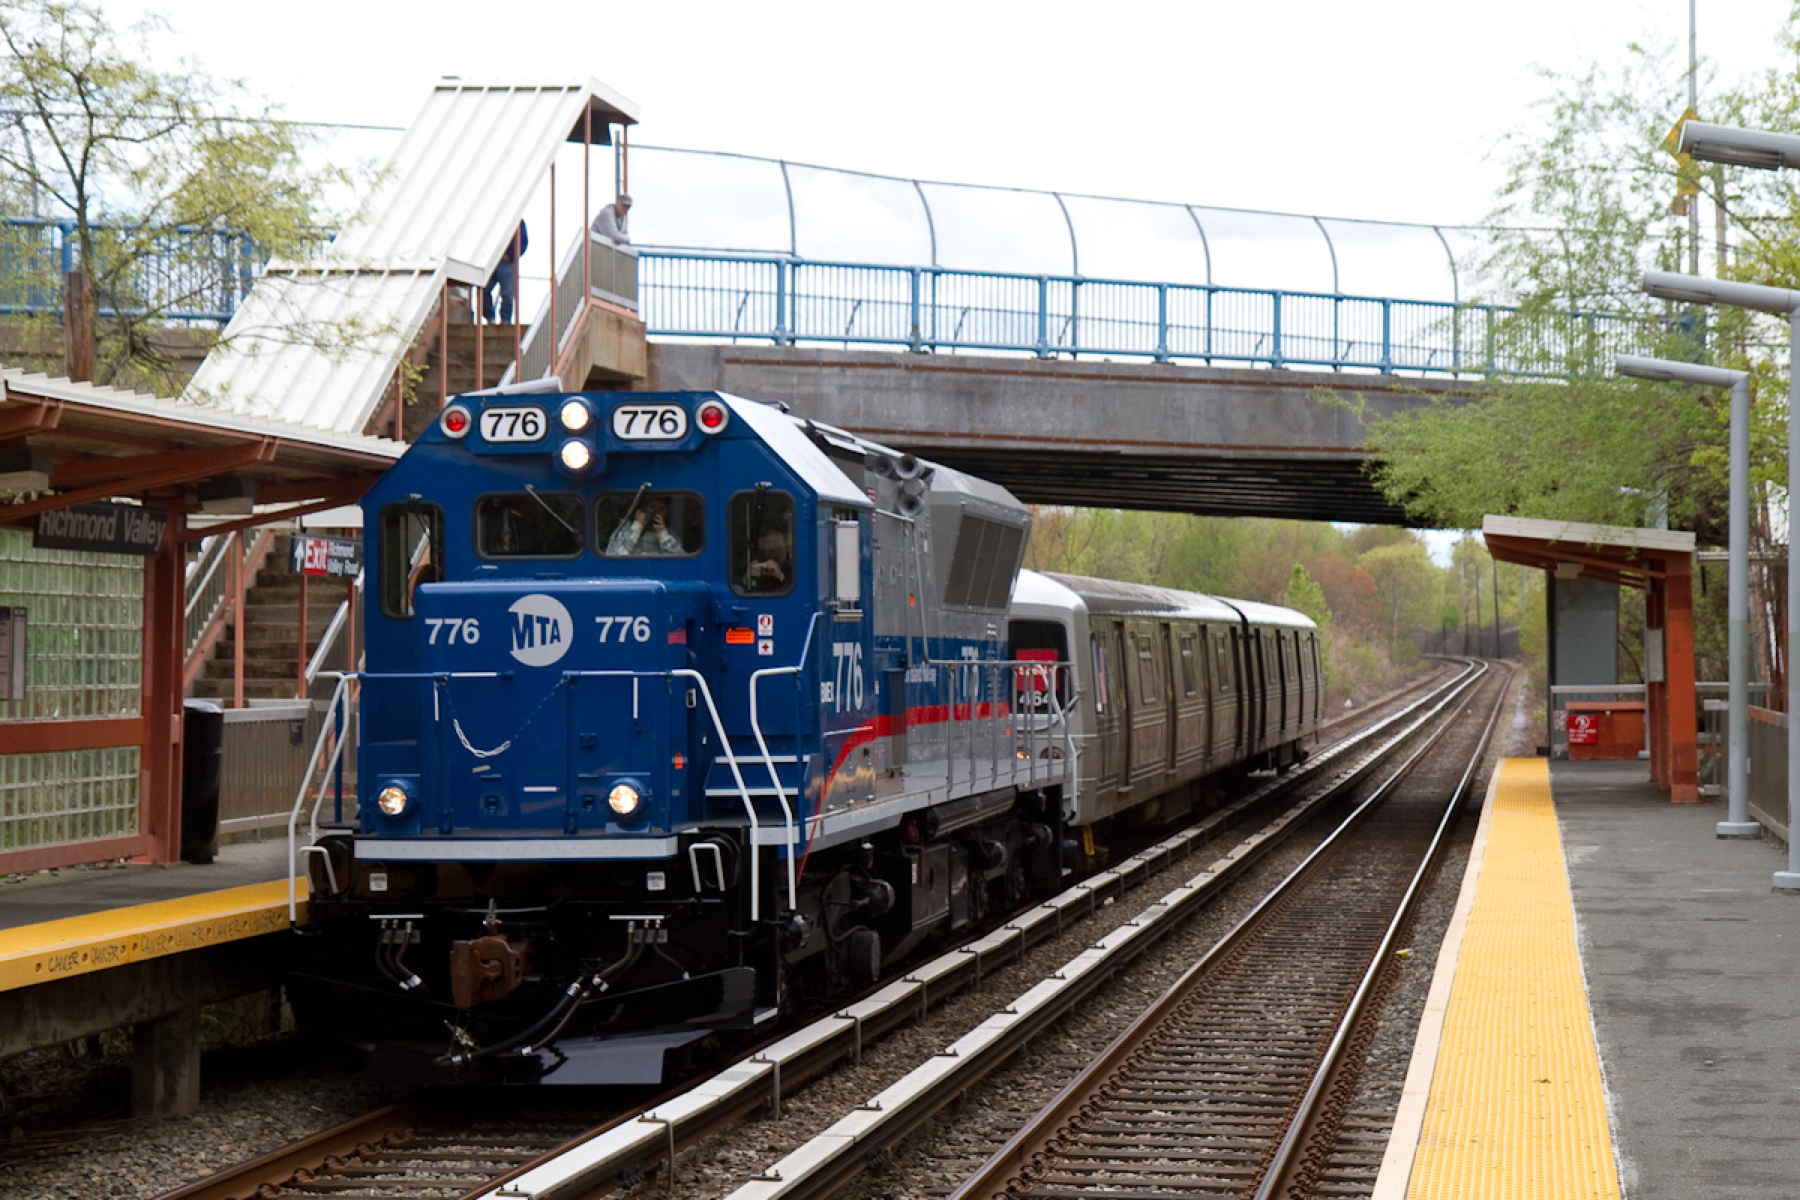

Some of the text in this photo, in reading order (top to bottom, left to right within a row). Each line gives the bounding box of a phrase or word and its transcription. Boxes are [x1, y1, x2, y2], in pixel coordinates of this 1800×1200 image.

[486, 412, 539, 437] 776
[620, 409, 679, 434] 776
[39, 507, 166, 551] Richmond Valley
[304, 539, 328, 569] Exit
[424, 618, 481, 645] 776
[508, 611, 561, 650] MTA
[594, 616, 651, 643] 776
[832, 641, 864, 713] 776
